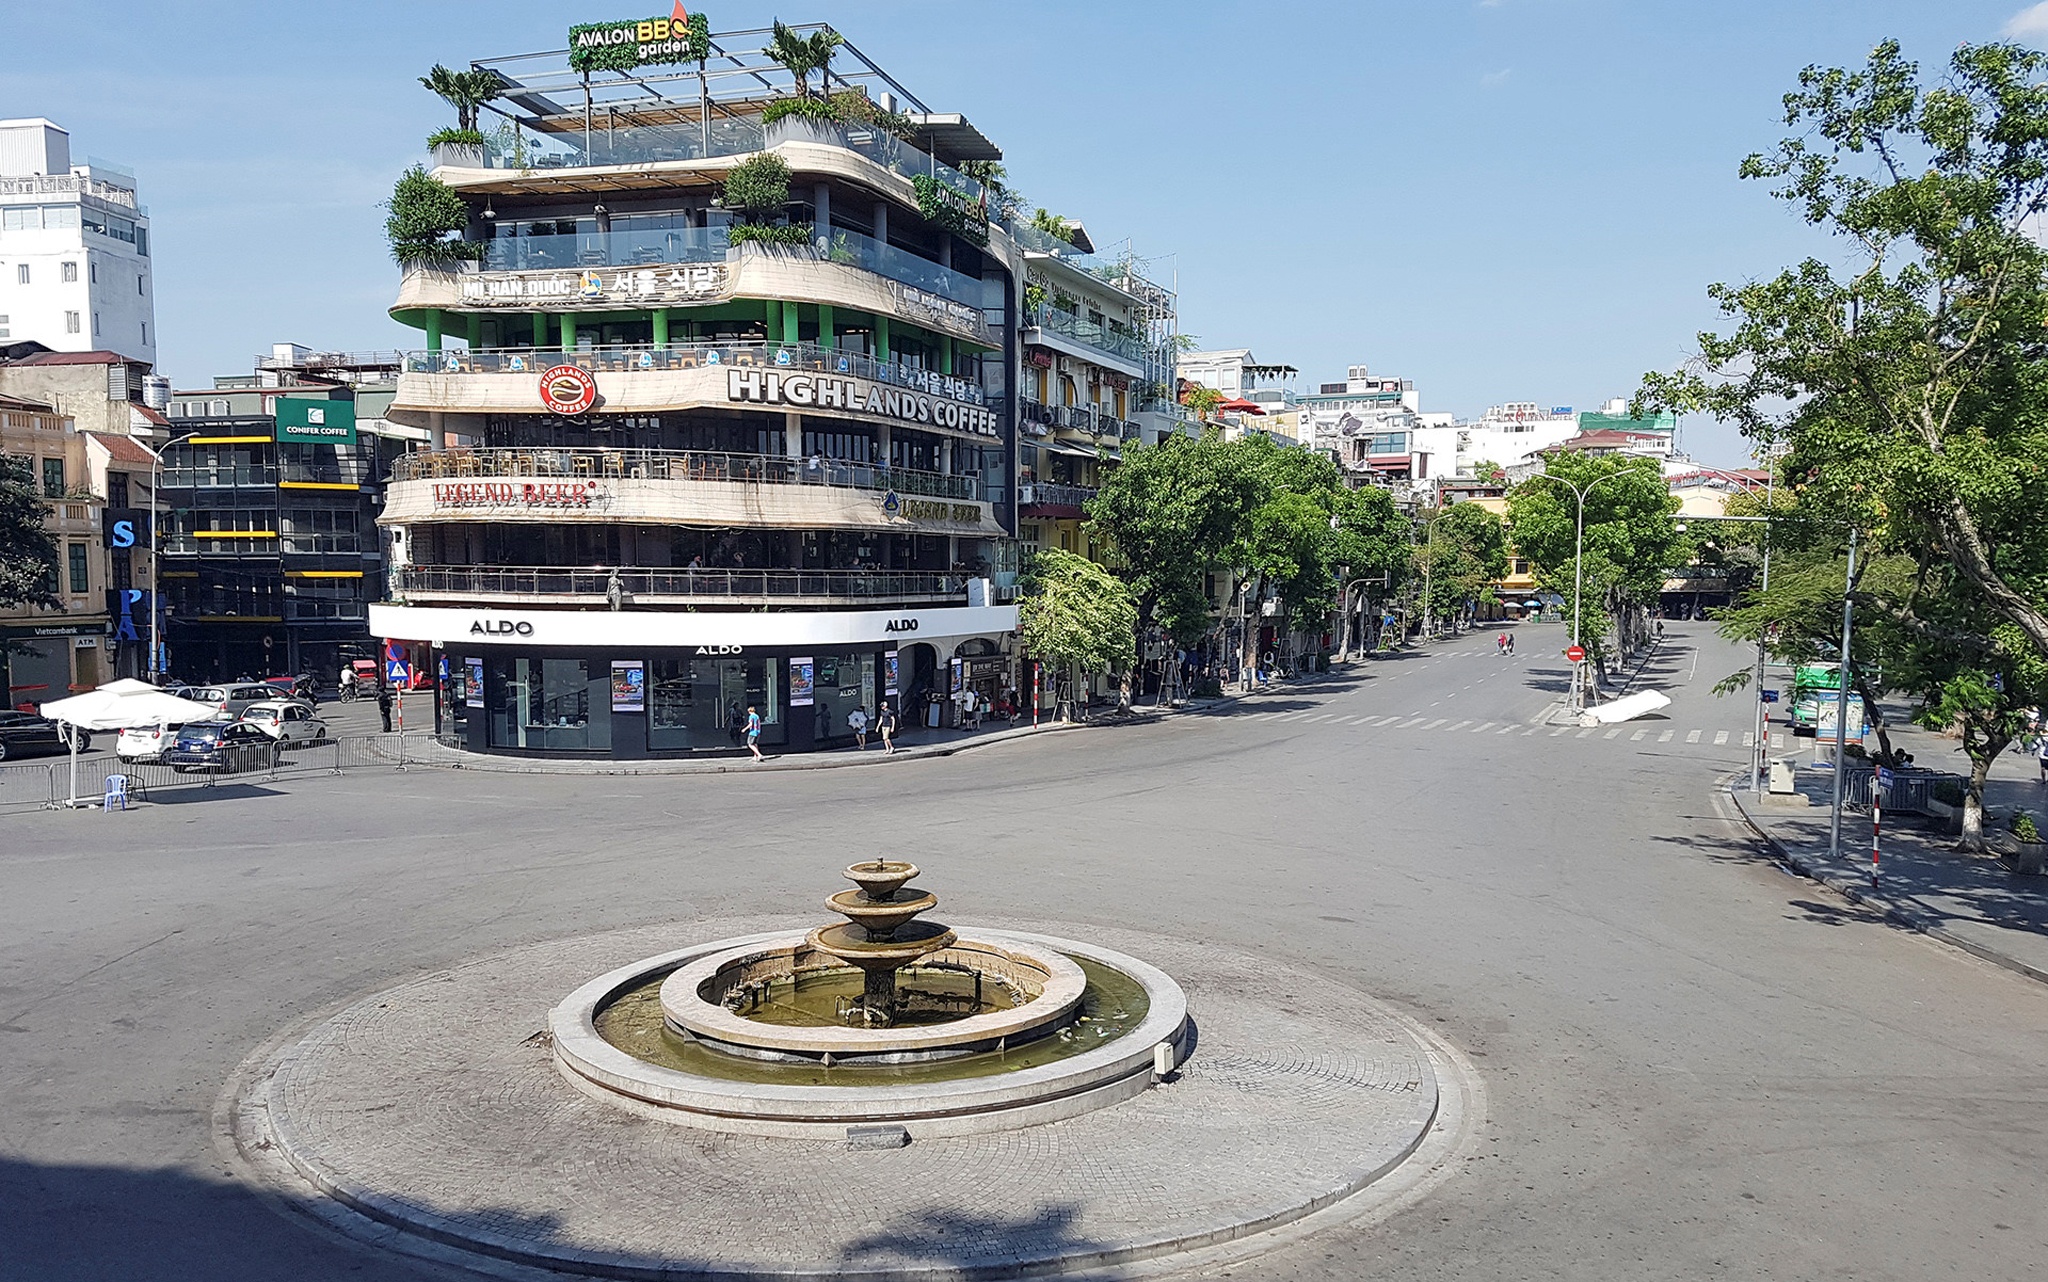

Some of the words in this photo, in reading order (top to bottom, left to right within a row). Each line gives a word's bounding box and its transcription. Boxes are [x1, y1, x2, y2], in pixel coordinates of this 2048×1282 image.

[577, 28, 635, 47] AVALON
[638, 41, 690, 59] garden
[611, 270, 657, 296] 서울
[665, 268, 715, 293] 식당
[541, 367, 592, 389] HIGHLANDS
[548, 400, 588, 412] COFFEE
[728, 369, 929, 422] HIGHLANDS
[932, 400, 997, 436] COFFEE
[286, 426, 320, 435] CONIFER
[320, 427, 348, 436] COFFEE
[434, 483, 513, 502] LEGEND
[522, 483, 587, 503] BEER
[34, 627, 78, 636] Vietcombank
[469, 620, 533, 635] ALDO
[885, 618, 919, 633] ALDO
[78, 638, 95, 646] ATM
[695, 644, 743, 655] ALDO
[839, 688, 858, 698] ALDO
